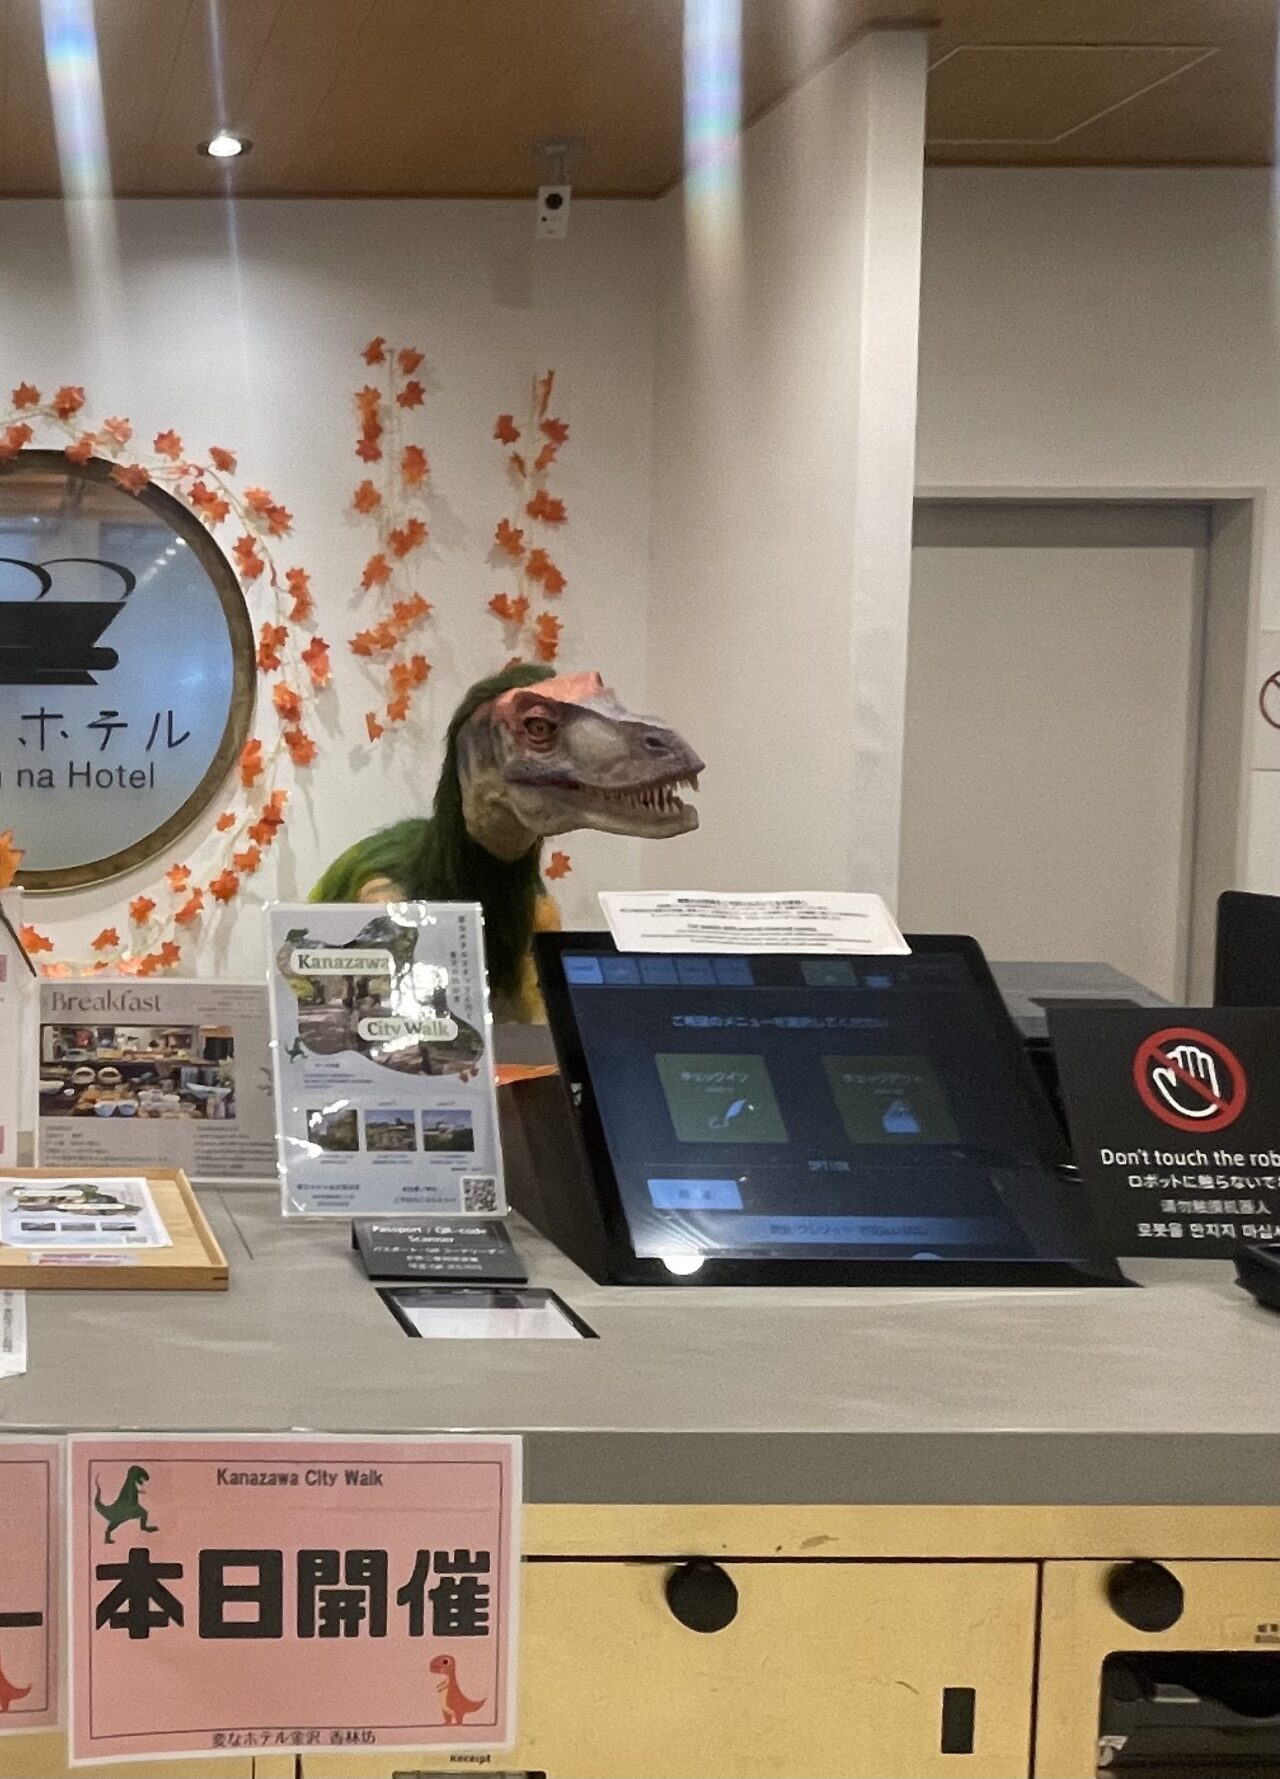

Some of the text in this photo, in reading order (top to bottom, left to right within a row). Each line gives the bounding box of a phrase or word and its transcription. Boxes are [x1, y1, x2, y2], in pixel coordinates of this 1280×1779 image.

[17, 768, 55, 789] na
[69, 760, 155, 789] Hotel
[52, 989, 161, 1012] Breakfast
[367, 1021, 450, 1037] City Walk
[1101, 1149, 1150, 1165] Don't
[1155, 1150, 1208, 1166] touch
[1213, 1150, 1245, 1167] the
[1128, 1174, 1280, 1189] ロボットに触らないで
[216, 1469, 383, 1488] Kanazawa City Walk
[95, 1547, 491, 1640] 本日開催
